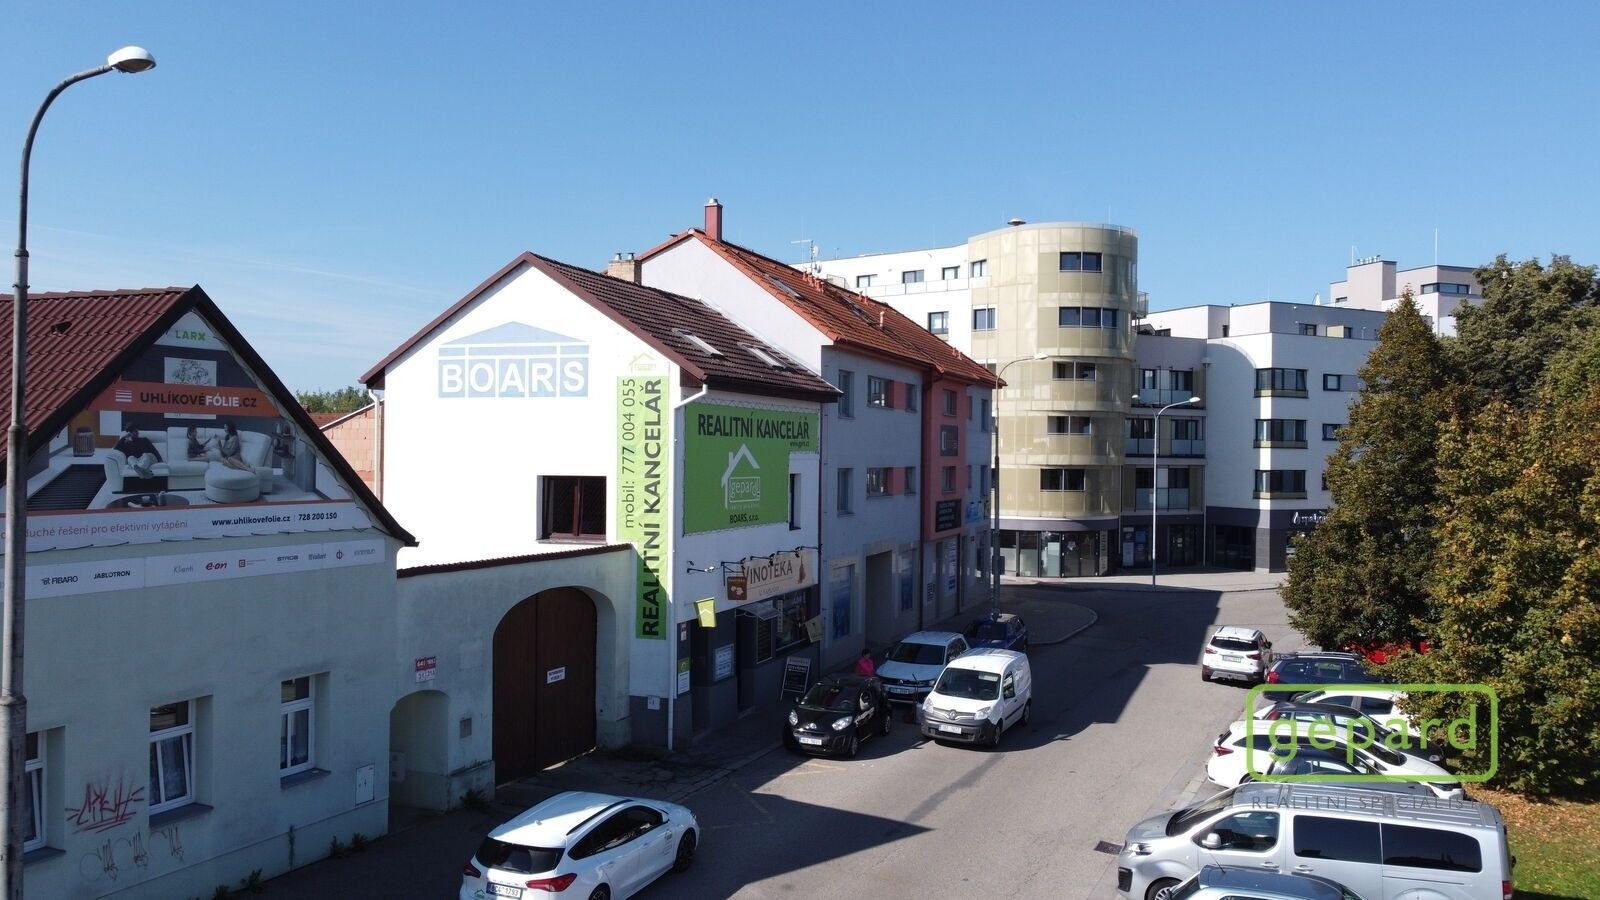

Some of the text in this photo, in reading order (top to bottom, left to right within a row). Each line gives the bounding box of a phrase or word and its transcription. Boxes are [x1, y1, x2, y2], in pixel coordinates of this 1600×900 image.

[176, 330, 206, 341] LARX
[442, 361, 585, 394] BOARS
[140, 390, 257, 408] UHLÍKOVÉFÓLIE.CZ
[698, 412, 809, 440] REALITNÍ KANCELÁŘ
[622, 378, 636, 529] mobil: 777 004 055
[639, 378, 662, 515] KANCELÁŘ
[58, 525, 88, 536] řešení
[91, 526, 108, 538] pro
[110, 521, 149, 533] efektivní
[152, 520, 188, 533] vytápění
[212, 512, 338, 526] www.uhlikovefolie.cz 728 200 150
[51, 570, 131, 585] FIBARO JABLOTRON
[639, 522, 661, 637] REALITNÍ
